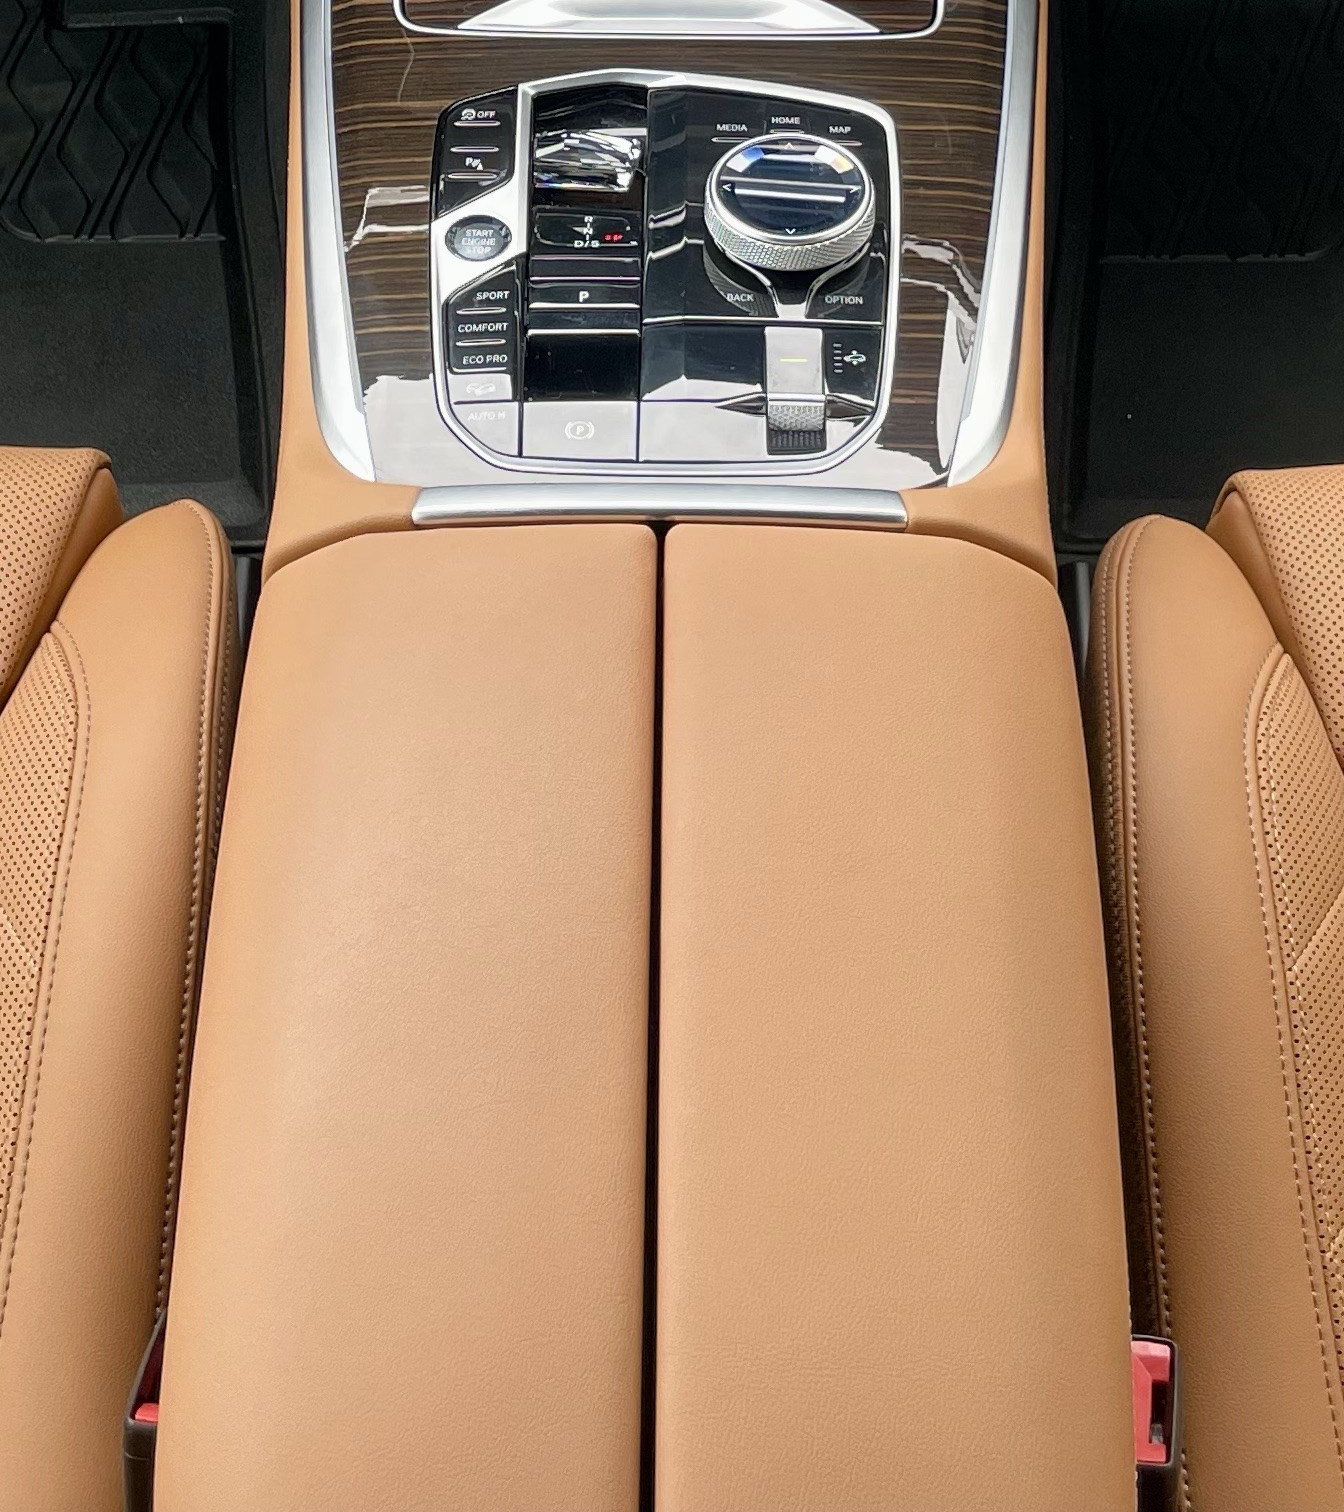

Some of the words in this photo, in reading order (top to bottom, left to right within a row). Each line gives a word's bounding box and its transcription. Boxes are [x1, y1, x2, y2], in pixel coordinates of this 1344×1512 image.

[476, 110, 496, 119] OFF
[771, 116, 801, 125] HOME
[716, 123, 748, 132] MEDIA
[829, 126, 851, 134] MAP
[584, 215, 594, 224] R
[465, 229, 494, 238] START
[461, 237, 497, 247] ENGINE
[466, 245, 492, 255] STOP
[476, 290, 511, 301] SPORT
[578, 291, 590, 303] P
[726, 293, 755, 303] BACK
[824, 295, 864, 305] OPTION
[457, 322, 509, 334] COMFORT
[462, 355, 485, 365] ECO
[485, 354, 508, 364] PRO
[467, 411, 496, 421] AUTO
